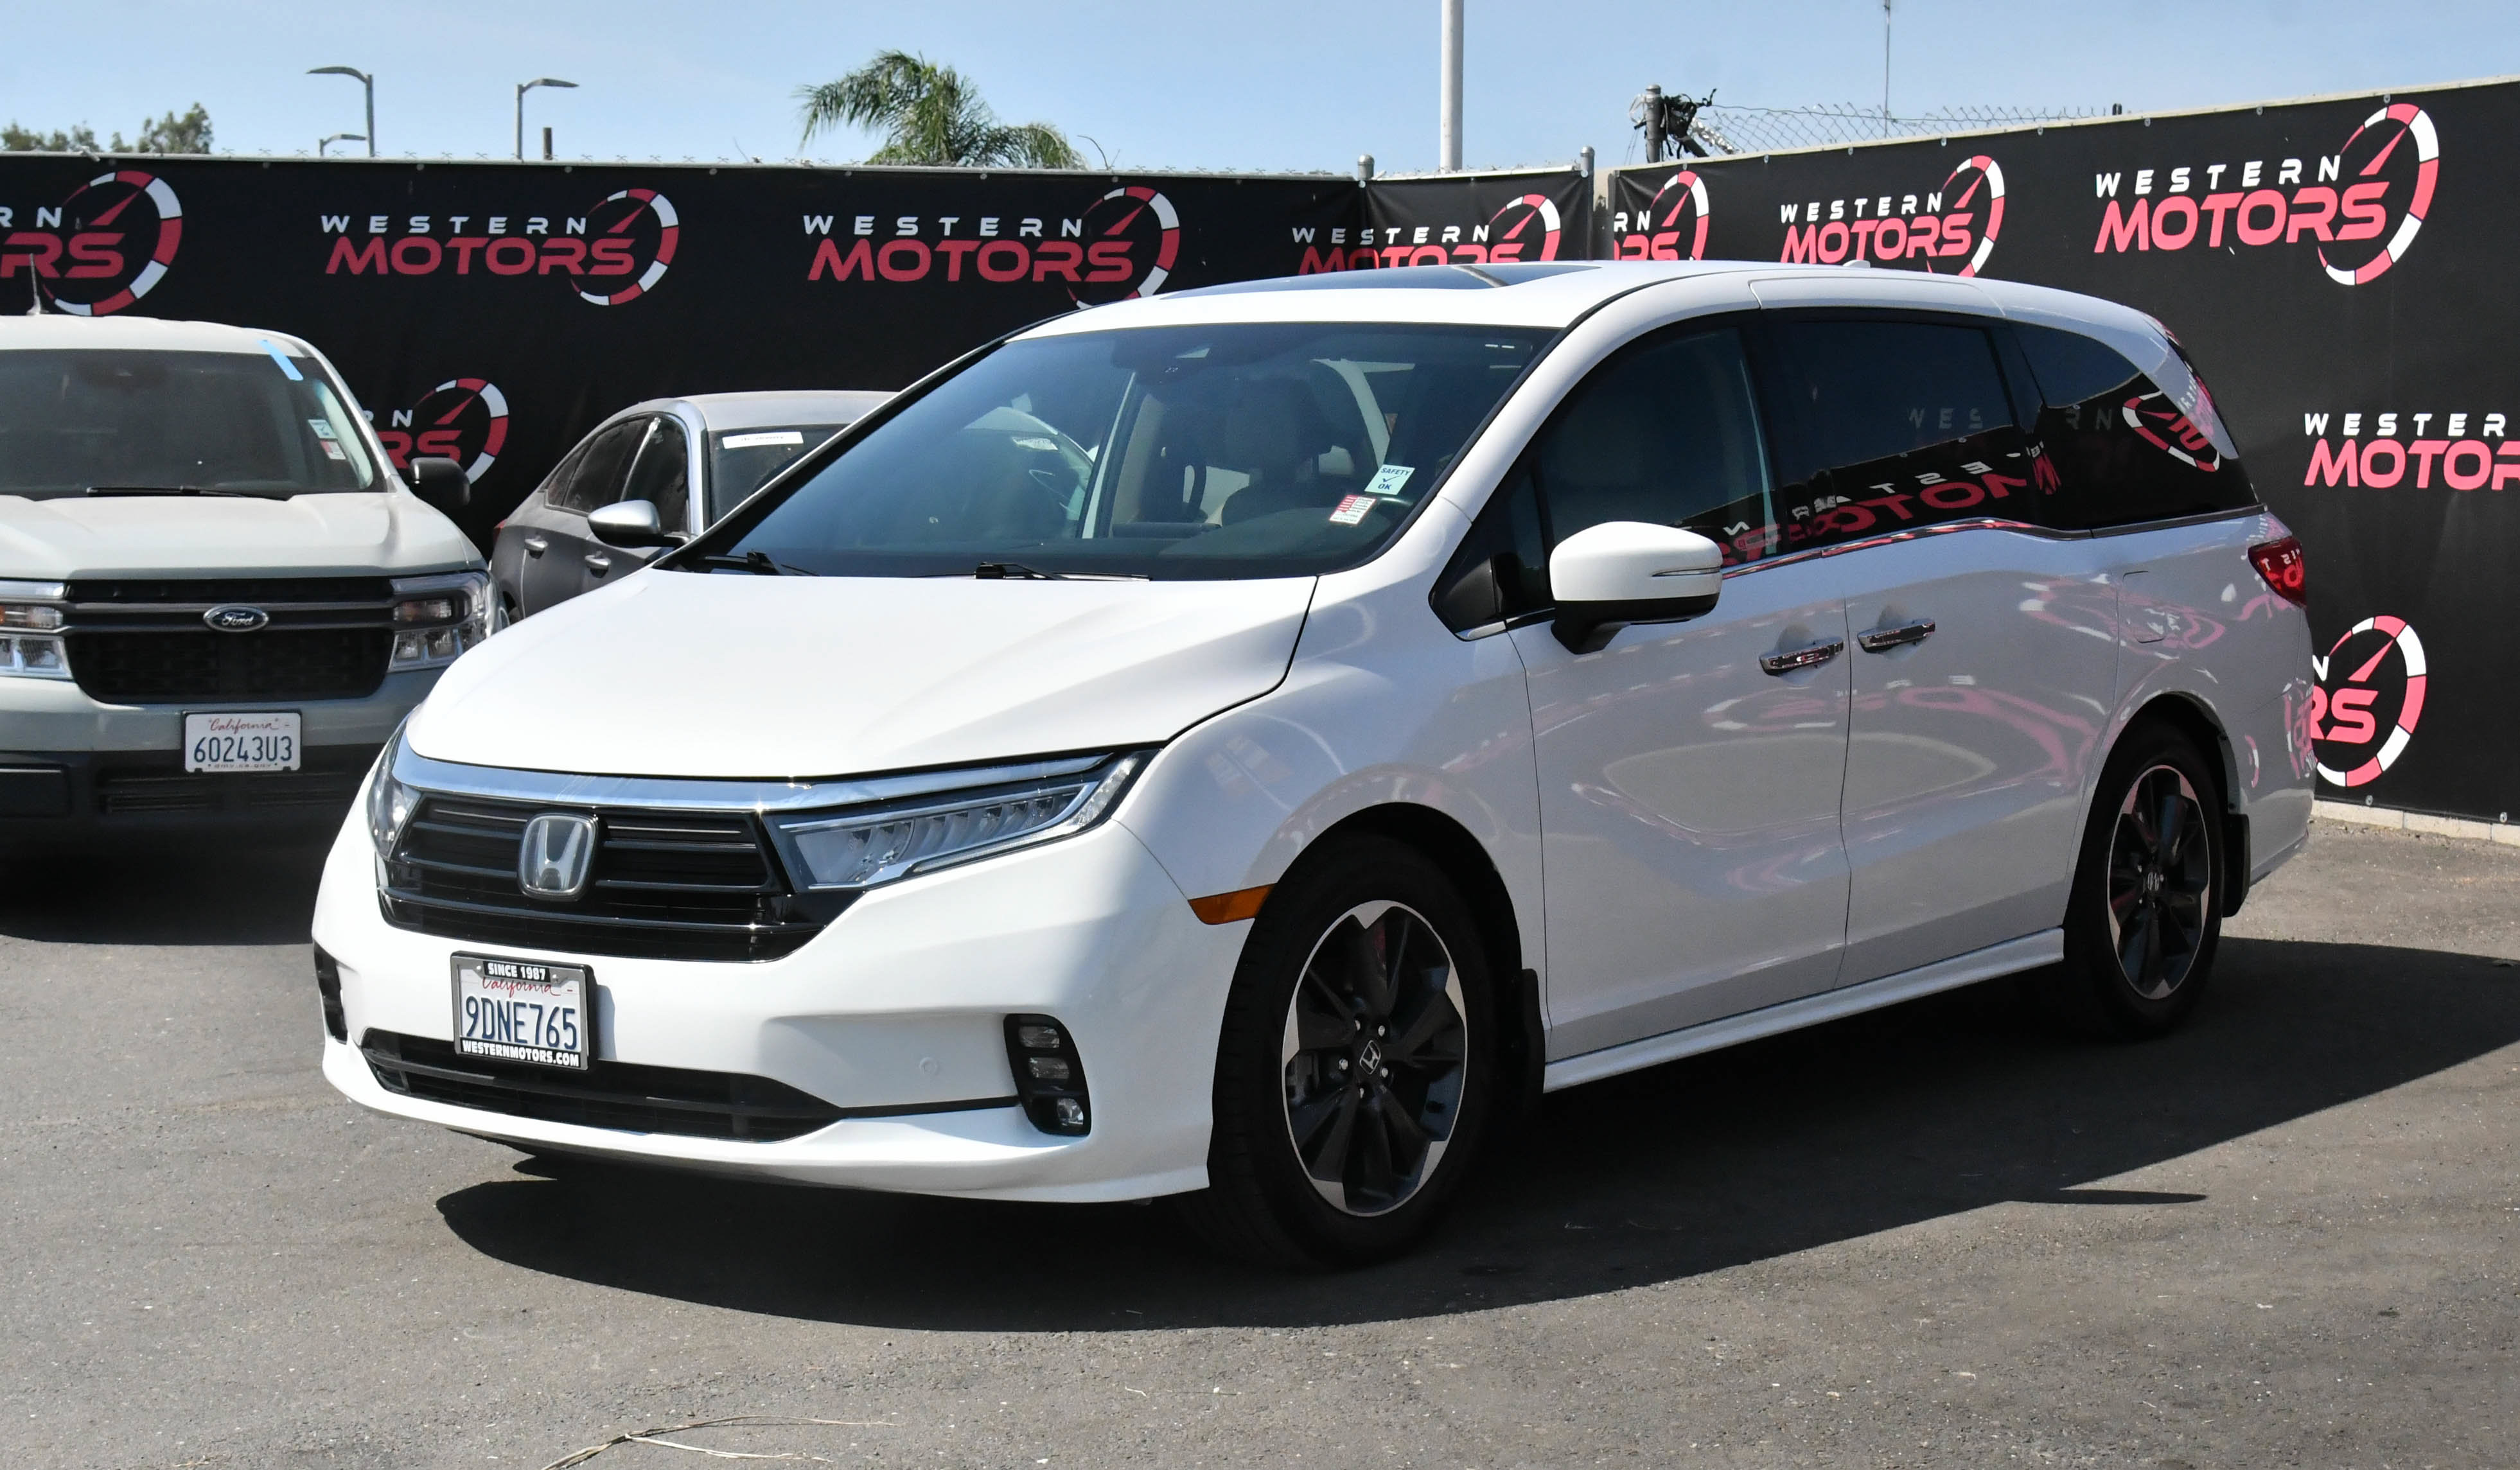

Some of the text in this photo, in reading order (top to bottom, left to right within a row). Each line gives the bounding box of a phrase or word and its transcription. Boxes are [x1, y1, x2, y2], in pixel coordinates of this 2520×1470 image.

[2096, 155, 2341, 198] WESTERN
[1781, 192, 1943, 223] WESTERN
[2094, 182, 2390, 253] MOTORS
[321, 216, 586, 234] WESTERN
[804, 215, 1082, 237] WESTERN
[1292, 225, 1489, 245] WESTERN
[1780, 213, 1973, 264] MOTORS
[326, 236, 635, 275] MOTORS
[807, 238, 1133, 281] MOTORS
[1380, 468, 1411, 476] SAFETY
[222, 611, 254, 626] Ford
[210, 719, 279, 735] California
[194, 736, 292, 763] 60243U3
[488, 963, 546, 981] SINCE 1987
[465, 995, 577, 1050] 9DNE765
[462, 1039, 579, 1067] WESTERNMOTORS.COM
